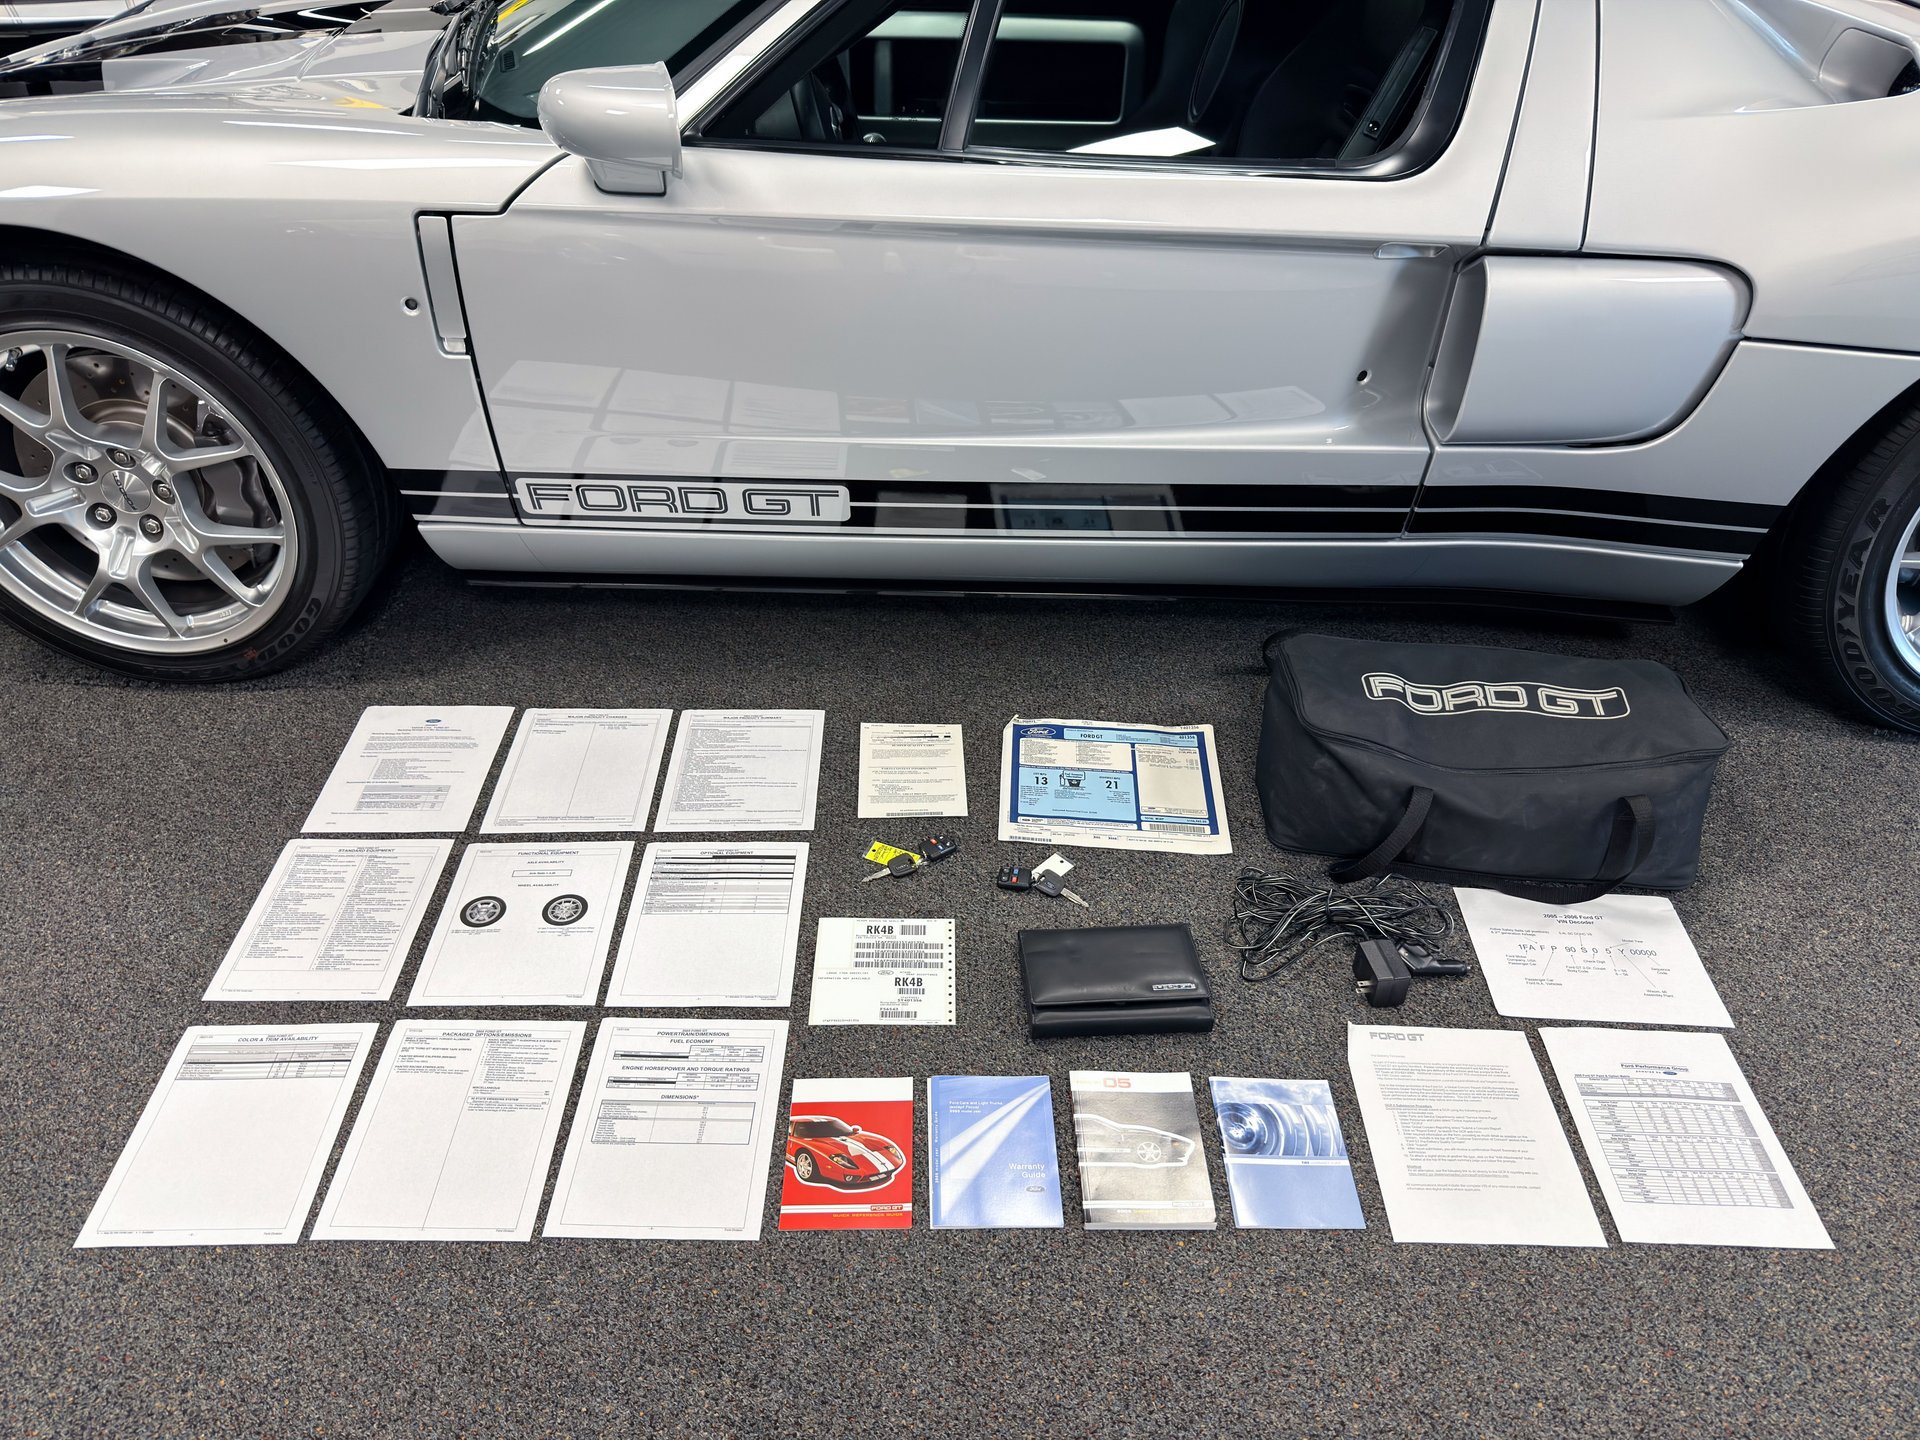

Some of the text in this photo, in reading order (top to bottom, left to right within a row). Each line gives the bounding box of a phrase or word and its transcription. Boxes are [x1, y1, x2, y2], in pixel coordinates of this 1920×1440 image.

[526, 483, 839, 517] FORD GT
[1368, 676, 1618, 716] FORD GT
[1034, 776, 1049, 785] 13
[1105, 780, 1118, 789] 21
[866, 925, 894, 935] RK4B
[1629, 948, 1657, 956] 00000
[894, 977, 923, 987] RK4B
[1369, 1031, 1425, 1041] FORD GT
[1103, 1077, 1132, 1088] 05
[1008, 1163, 1045, 1171] Warranty
[1021, 1171, 1046, 1179] Guide
